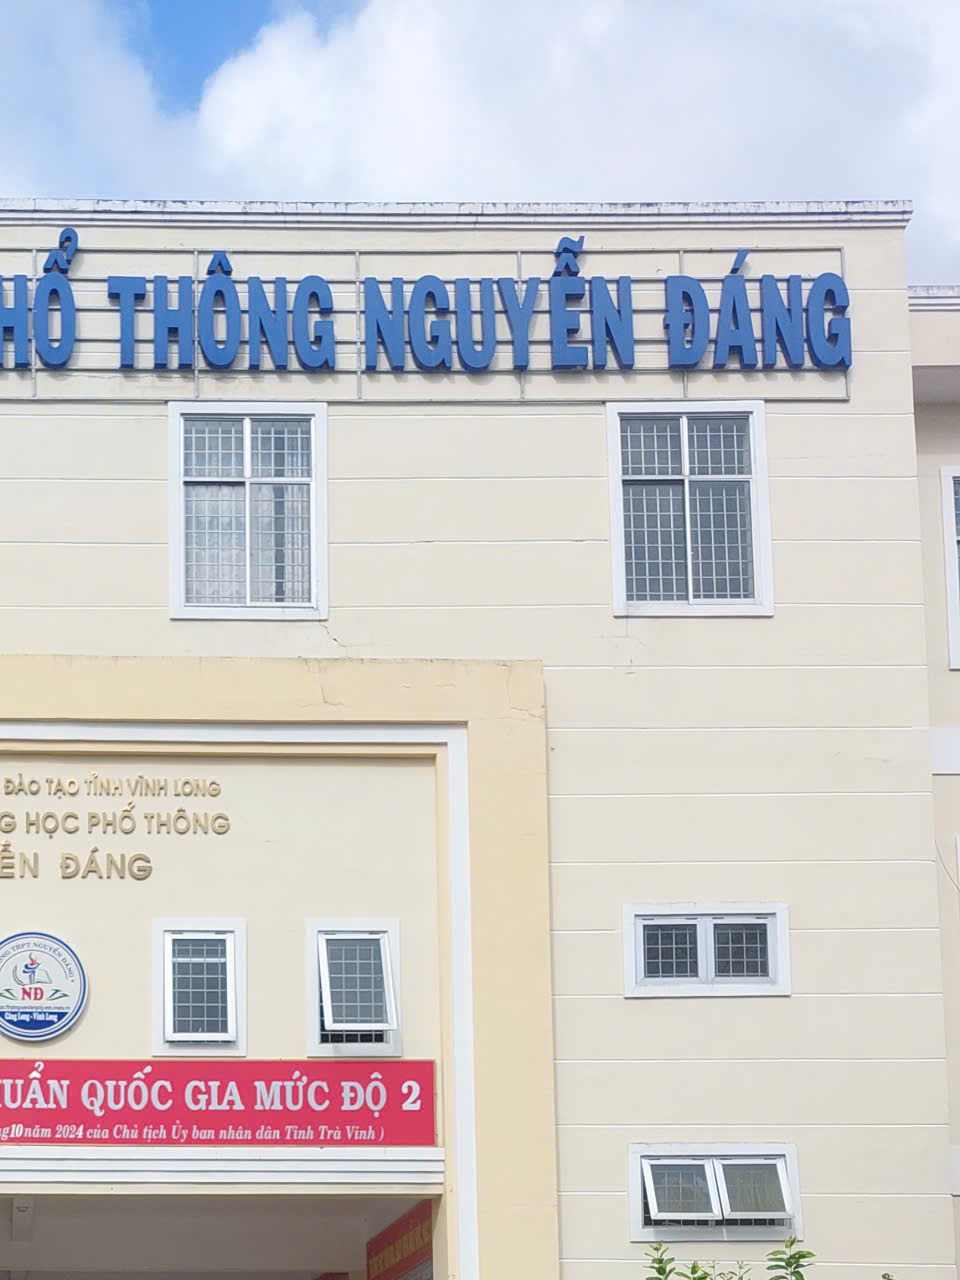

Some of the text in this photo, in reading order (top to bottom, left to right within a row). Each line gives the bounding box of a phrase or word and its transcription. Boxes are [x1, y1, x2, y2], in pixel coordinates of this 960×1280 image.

[107, 250, 336, 370] THÔNG
[363, 237, 635, 371] NGUYỄN
[664, 249, 852, 369] ĐÁNG
[4, 773, 40, 796] ĐÀO
[46, 778, 80, 799] TẠO
[173, 778, 221, 798] LONG
[25, 811, 80, 839] HỌC
[144, 808, 230, 836] THÔNG
[60, 846, 153, 881] ĐÁNG
[81, 1065, 173, 1117] QUỐC
[184, 1079, 245, 1111] GIA
[253, 1070, 330, 1111] MỨC
[340, 1072, 388, 1118] ĐỘ
[401, 1080, 422, 1111] 2
[55, 1124, 84, 1139] 2024
[87, 1124, 109, 1139] của
[113, 1124, 138, 1140] Chủ
[143, 1125, 167, 1142] tịch
[172, 1120, 188, 1142] Ủy
[192, 1125, 215, 1140] ban
[219, 1125, 252, 1140] nhân
[256, 1125, 280, 1140] dân
[318, 1125, 341, 1140] Trà
[346, 1125, 375, 1140] Vinh
